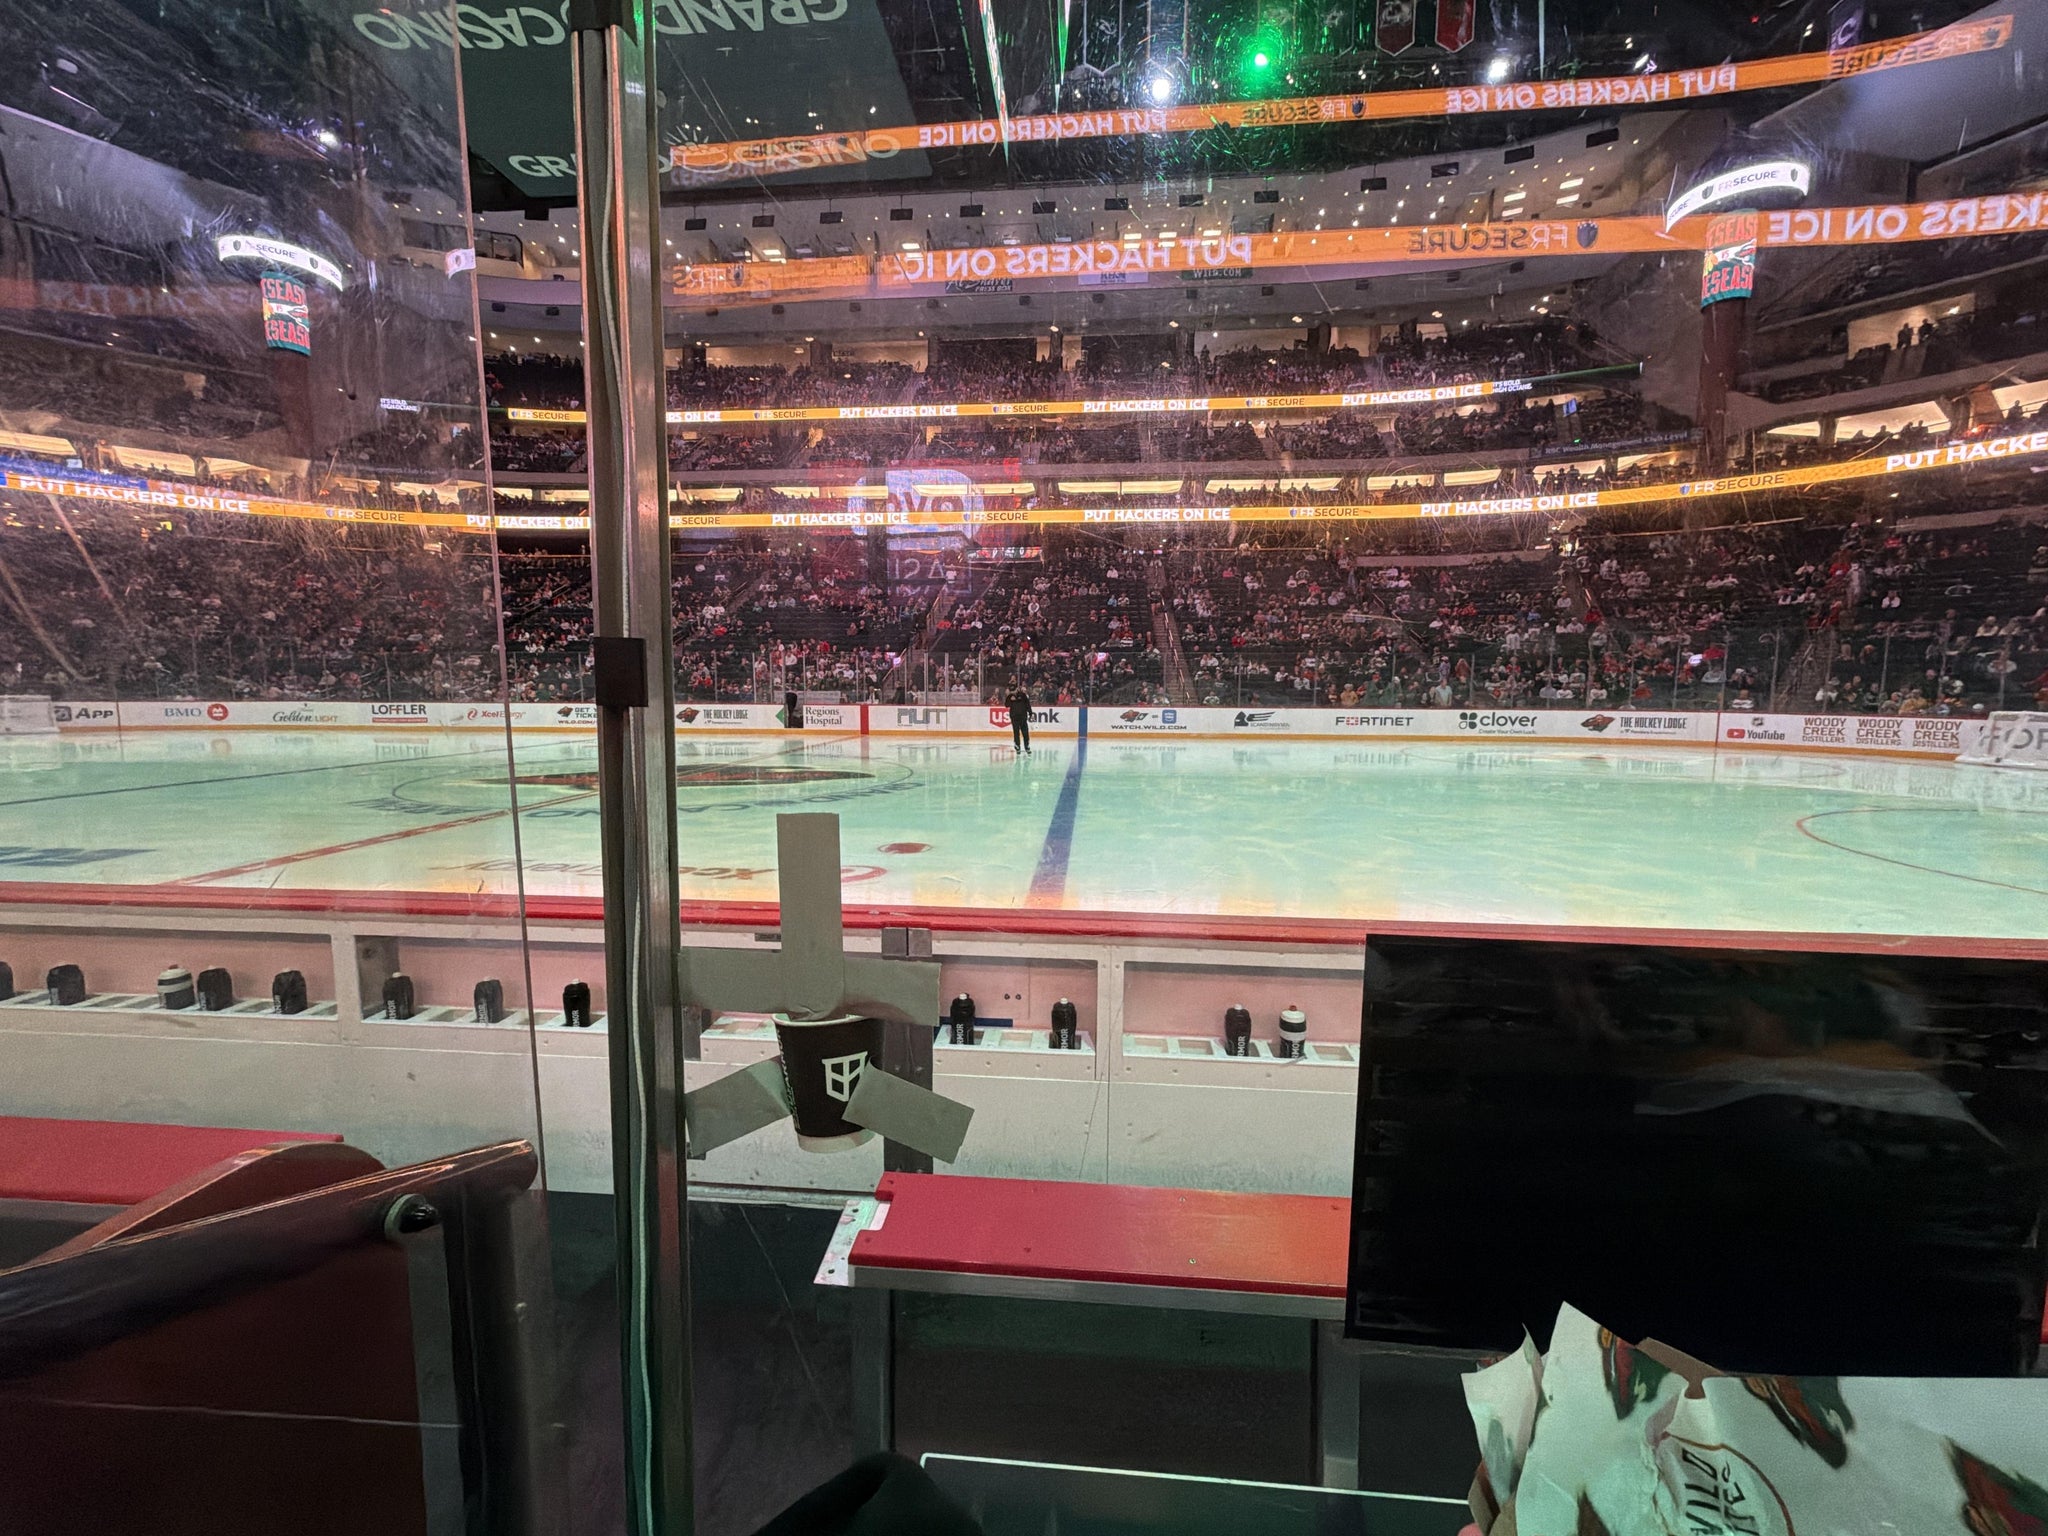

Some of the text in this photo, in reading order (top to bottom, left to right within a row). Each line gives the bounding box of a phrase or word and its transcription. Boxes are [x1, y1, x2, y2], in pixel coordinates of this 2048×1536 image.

[353, 4, 565, 49] CASINO
[1341, 383, 1483, 406] PUT HACKERS ON ICE
[839, 404, 958, 418] PUT HACKERS ON ICE
[1083, 398, 1209, 412] PUT HACKERS ON ICE
[1885, 451, 1940, 470] PUT
[1694, 473, 1785, 494] FRSECURE
[19, 476, 66, 493] PUT
[75, 483, 179, 507] HACKERS
[183, 493, 215, 508] ON
[218, 497, 250, 512] ICE
[1420, 491, 1599, 516] PUT HACKERS ON ICE
[337, 510, 405, 523] FRSECURE
[771, 512, 909, 525] PUT HACKERS ON ICE
[1084, 507, 1231, 521] PUT HACKERS ON ICE
[1300, 507, 1359, 518] FRSECURE
[499, 516, 560, 528] HACKERS
[564, 517, 583, 528] ON
[164, 707, 202, 717] BMO
[371, 704, 427, 716] LOFFLER
[804, 706, 839, 718] Regions
[272, 711, 312, 722] Golden
[804, 716, 842, 727] Hospital
[1335, 716, 1414, 727] FORTINET
[1480, 711, 1537, 726] clover
[1620, 716, 1688, 729] THE HOCKEY LODGE
[1804, 717, 1847, 727] WOODY
[1857, 719, 1903, 729] WOODY
[1914, 719, 1963, 731] WOODY
[1747, 729, 1785, 741] YouTube
[1802, 727, 1845, 736] CREEK
[1856, 729, 1901, 739] CREEK
[1913, 730, 1960, 742] CREEK
[1855, 738, 1902, 747] DISTILLERS
